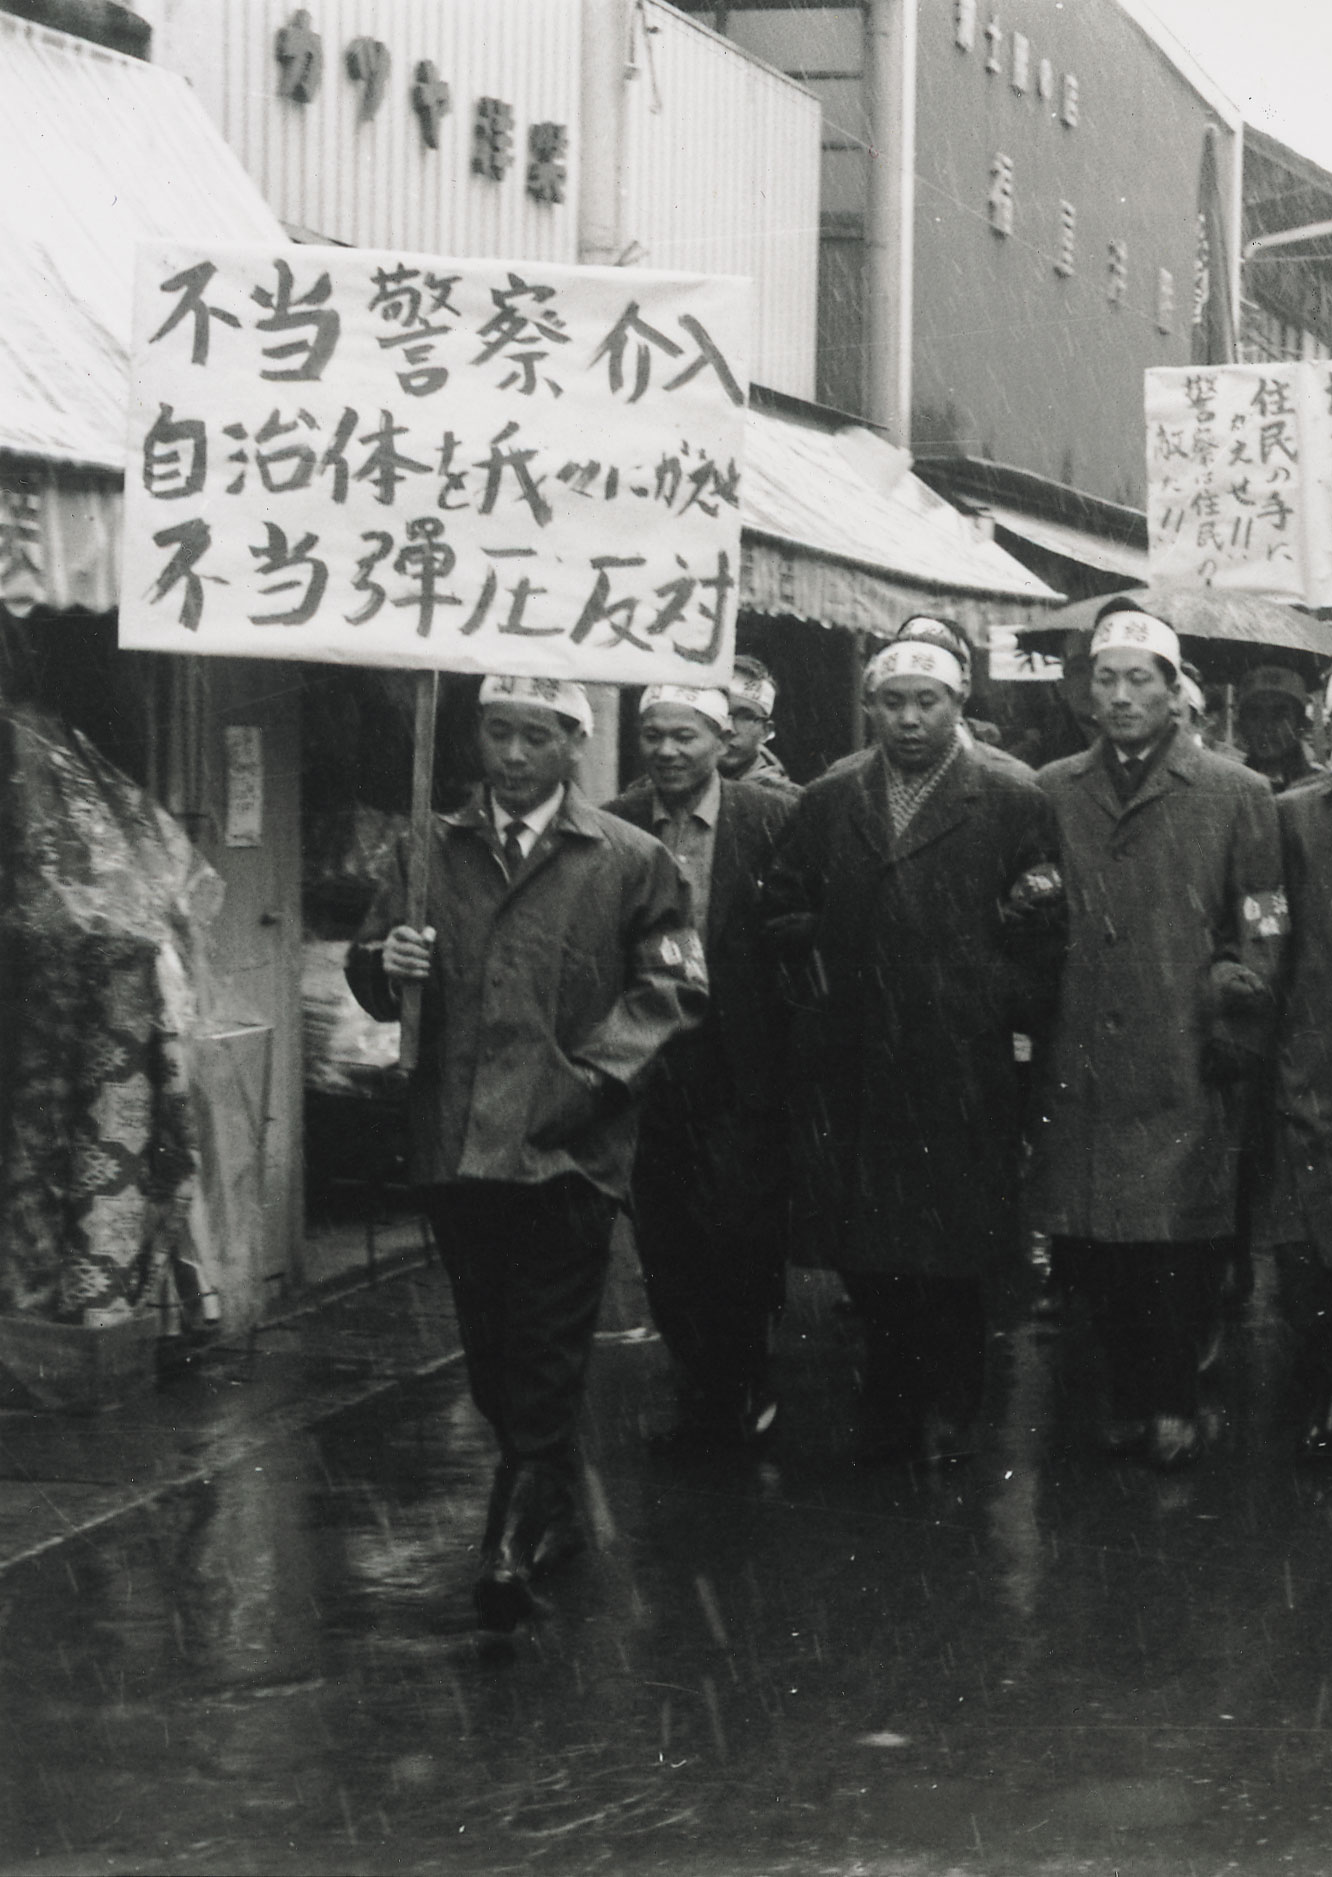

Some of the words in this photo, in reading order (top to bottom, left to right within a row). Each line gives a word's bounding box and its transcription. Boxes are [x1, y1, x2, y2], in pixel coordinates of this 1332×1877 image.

[150, 259, 745, 405] 不当警察介入
[1250, 378, 1299, 562] 住民の手に
